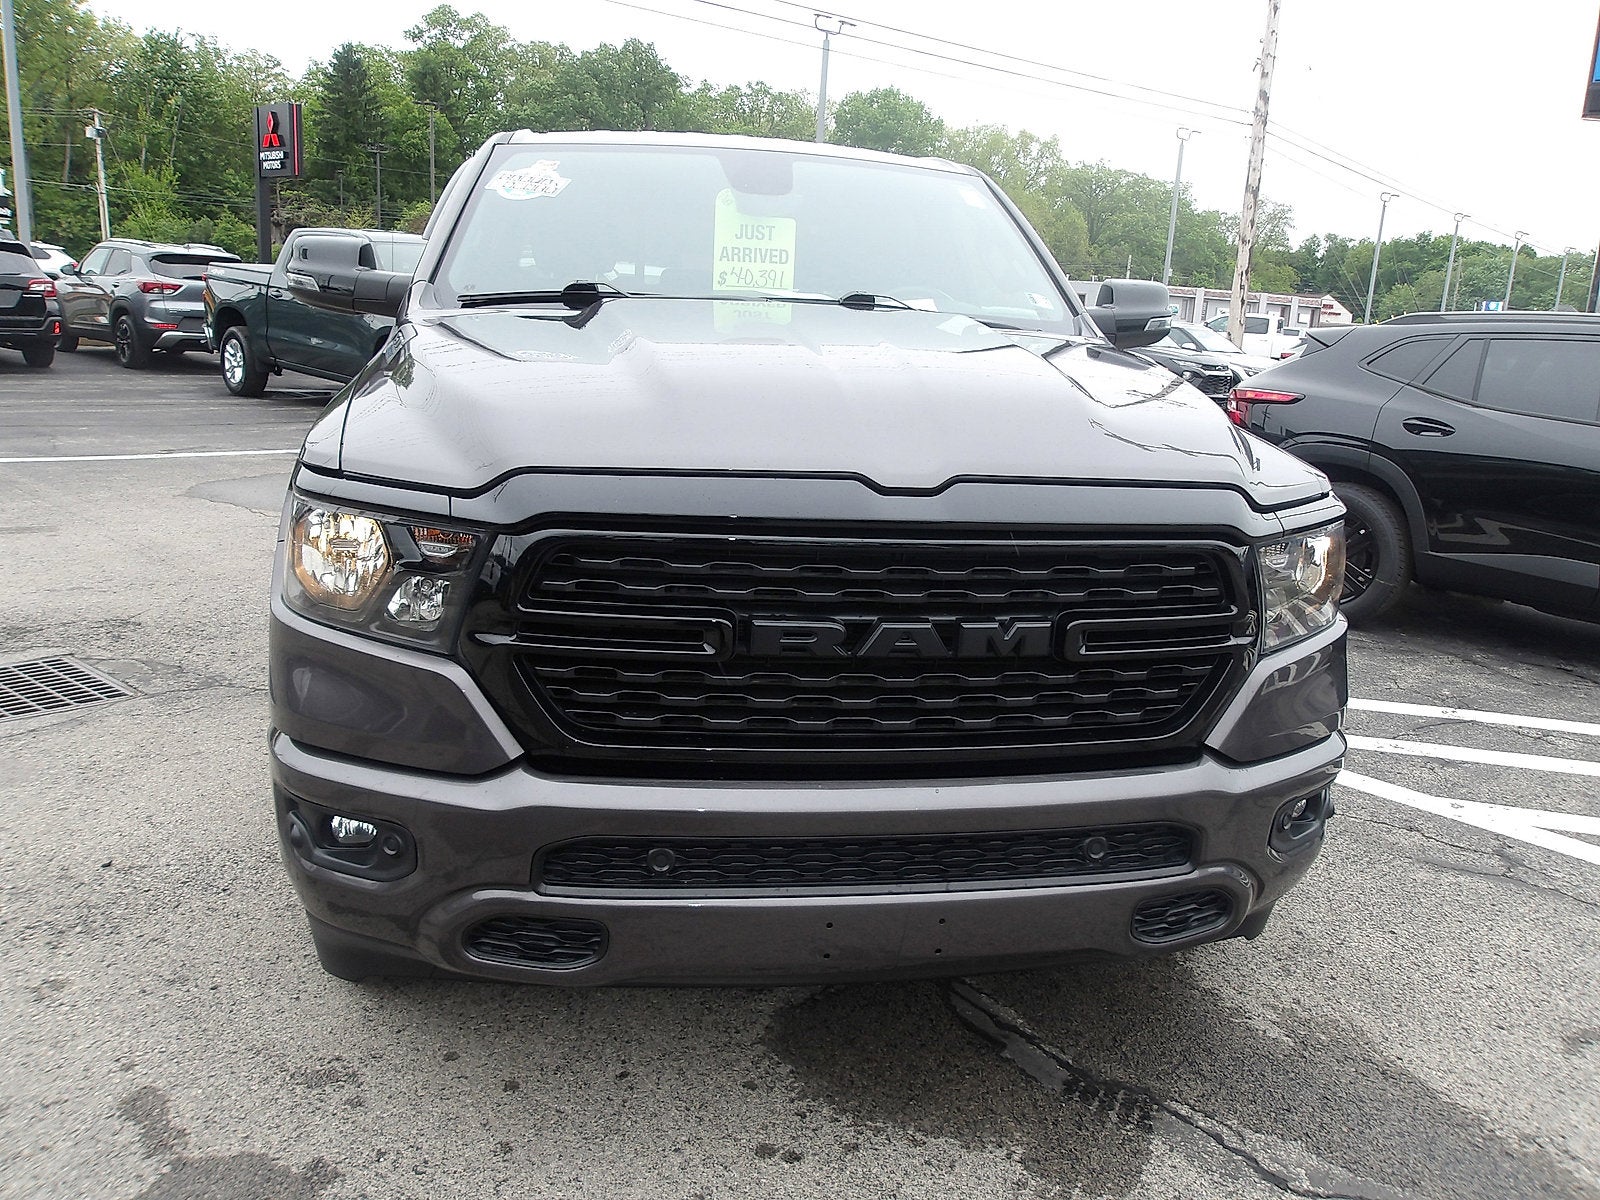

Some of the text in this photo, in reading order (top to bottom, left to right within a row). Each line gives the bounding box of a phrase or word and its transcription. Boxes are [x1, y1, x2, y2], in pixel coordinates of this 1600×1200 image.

[735, 224, 775, 241] JUST
[719, 246, 789, 265] ARRIVED
[752, 620, 1052, 656] RAM
